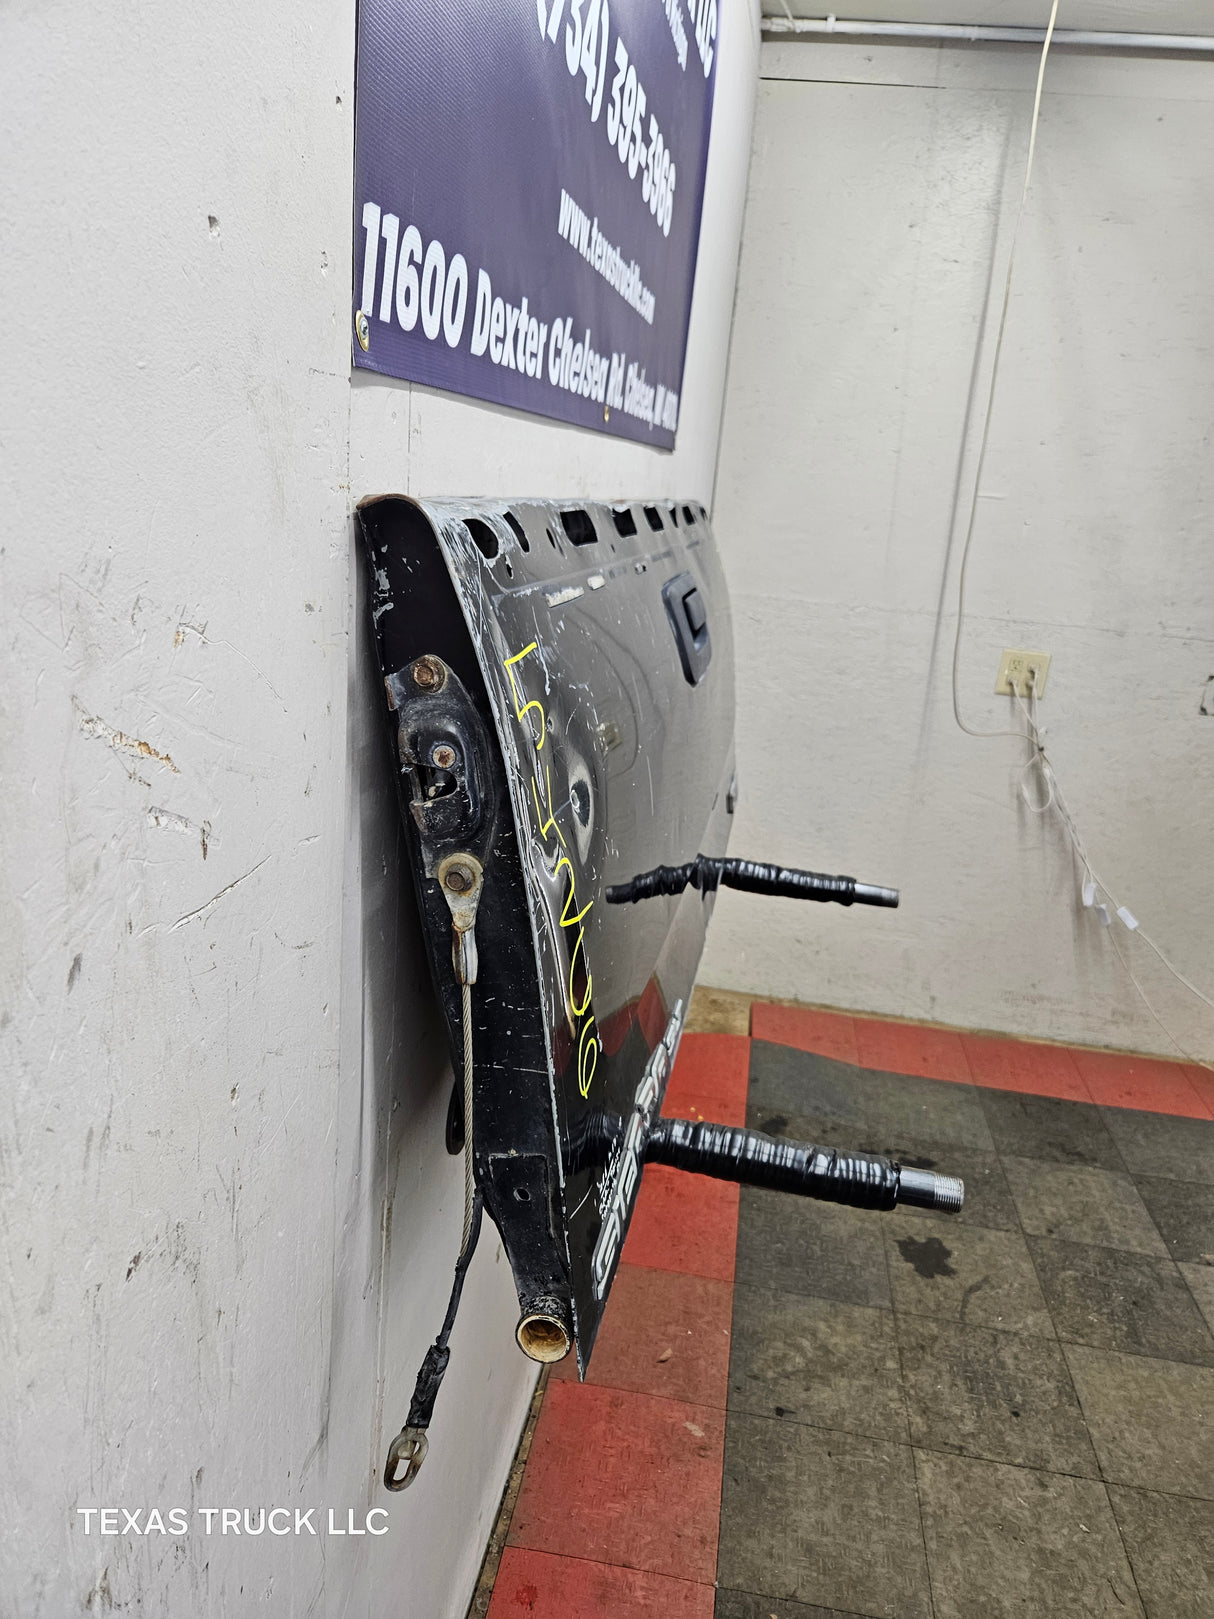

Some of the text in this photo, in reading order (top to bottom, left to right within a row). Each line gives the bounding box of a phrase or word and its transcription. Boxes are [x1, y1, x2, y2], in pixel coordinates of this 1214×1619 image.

[607, 36, 676, 238] 395-3966
[361, 201, 469, 348] 11600
[470, 267, 548, 380] Dexter
[548, 316, 611, 403] Chelsea
